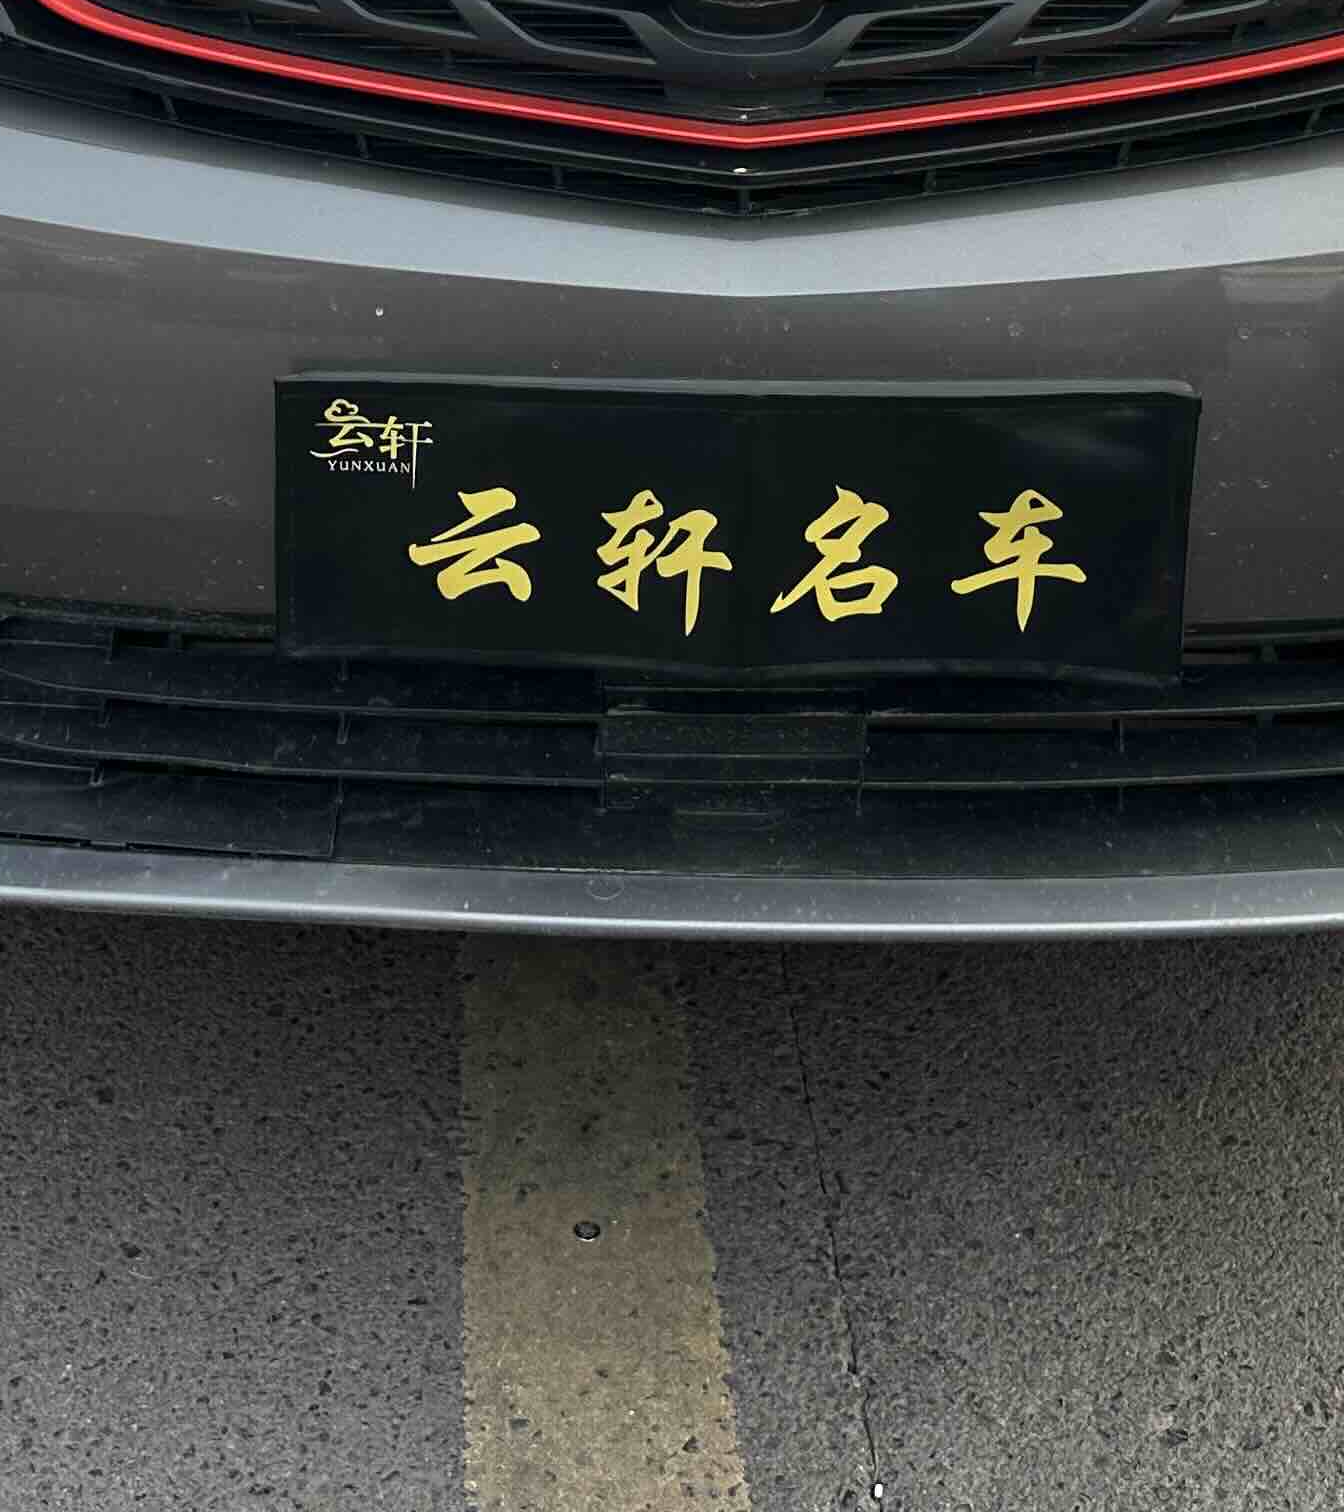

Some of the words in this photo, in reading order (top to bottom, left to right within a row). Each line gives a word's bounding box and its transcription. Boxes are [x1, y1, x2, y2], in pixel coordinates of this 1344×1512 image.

[310, 399, 433, 490] 云轩
[328, 459, 411, 473] YUNXUAN
[408, 485, 1088, 636] 云轩名车
